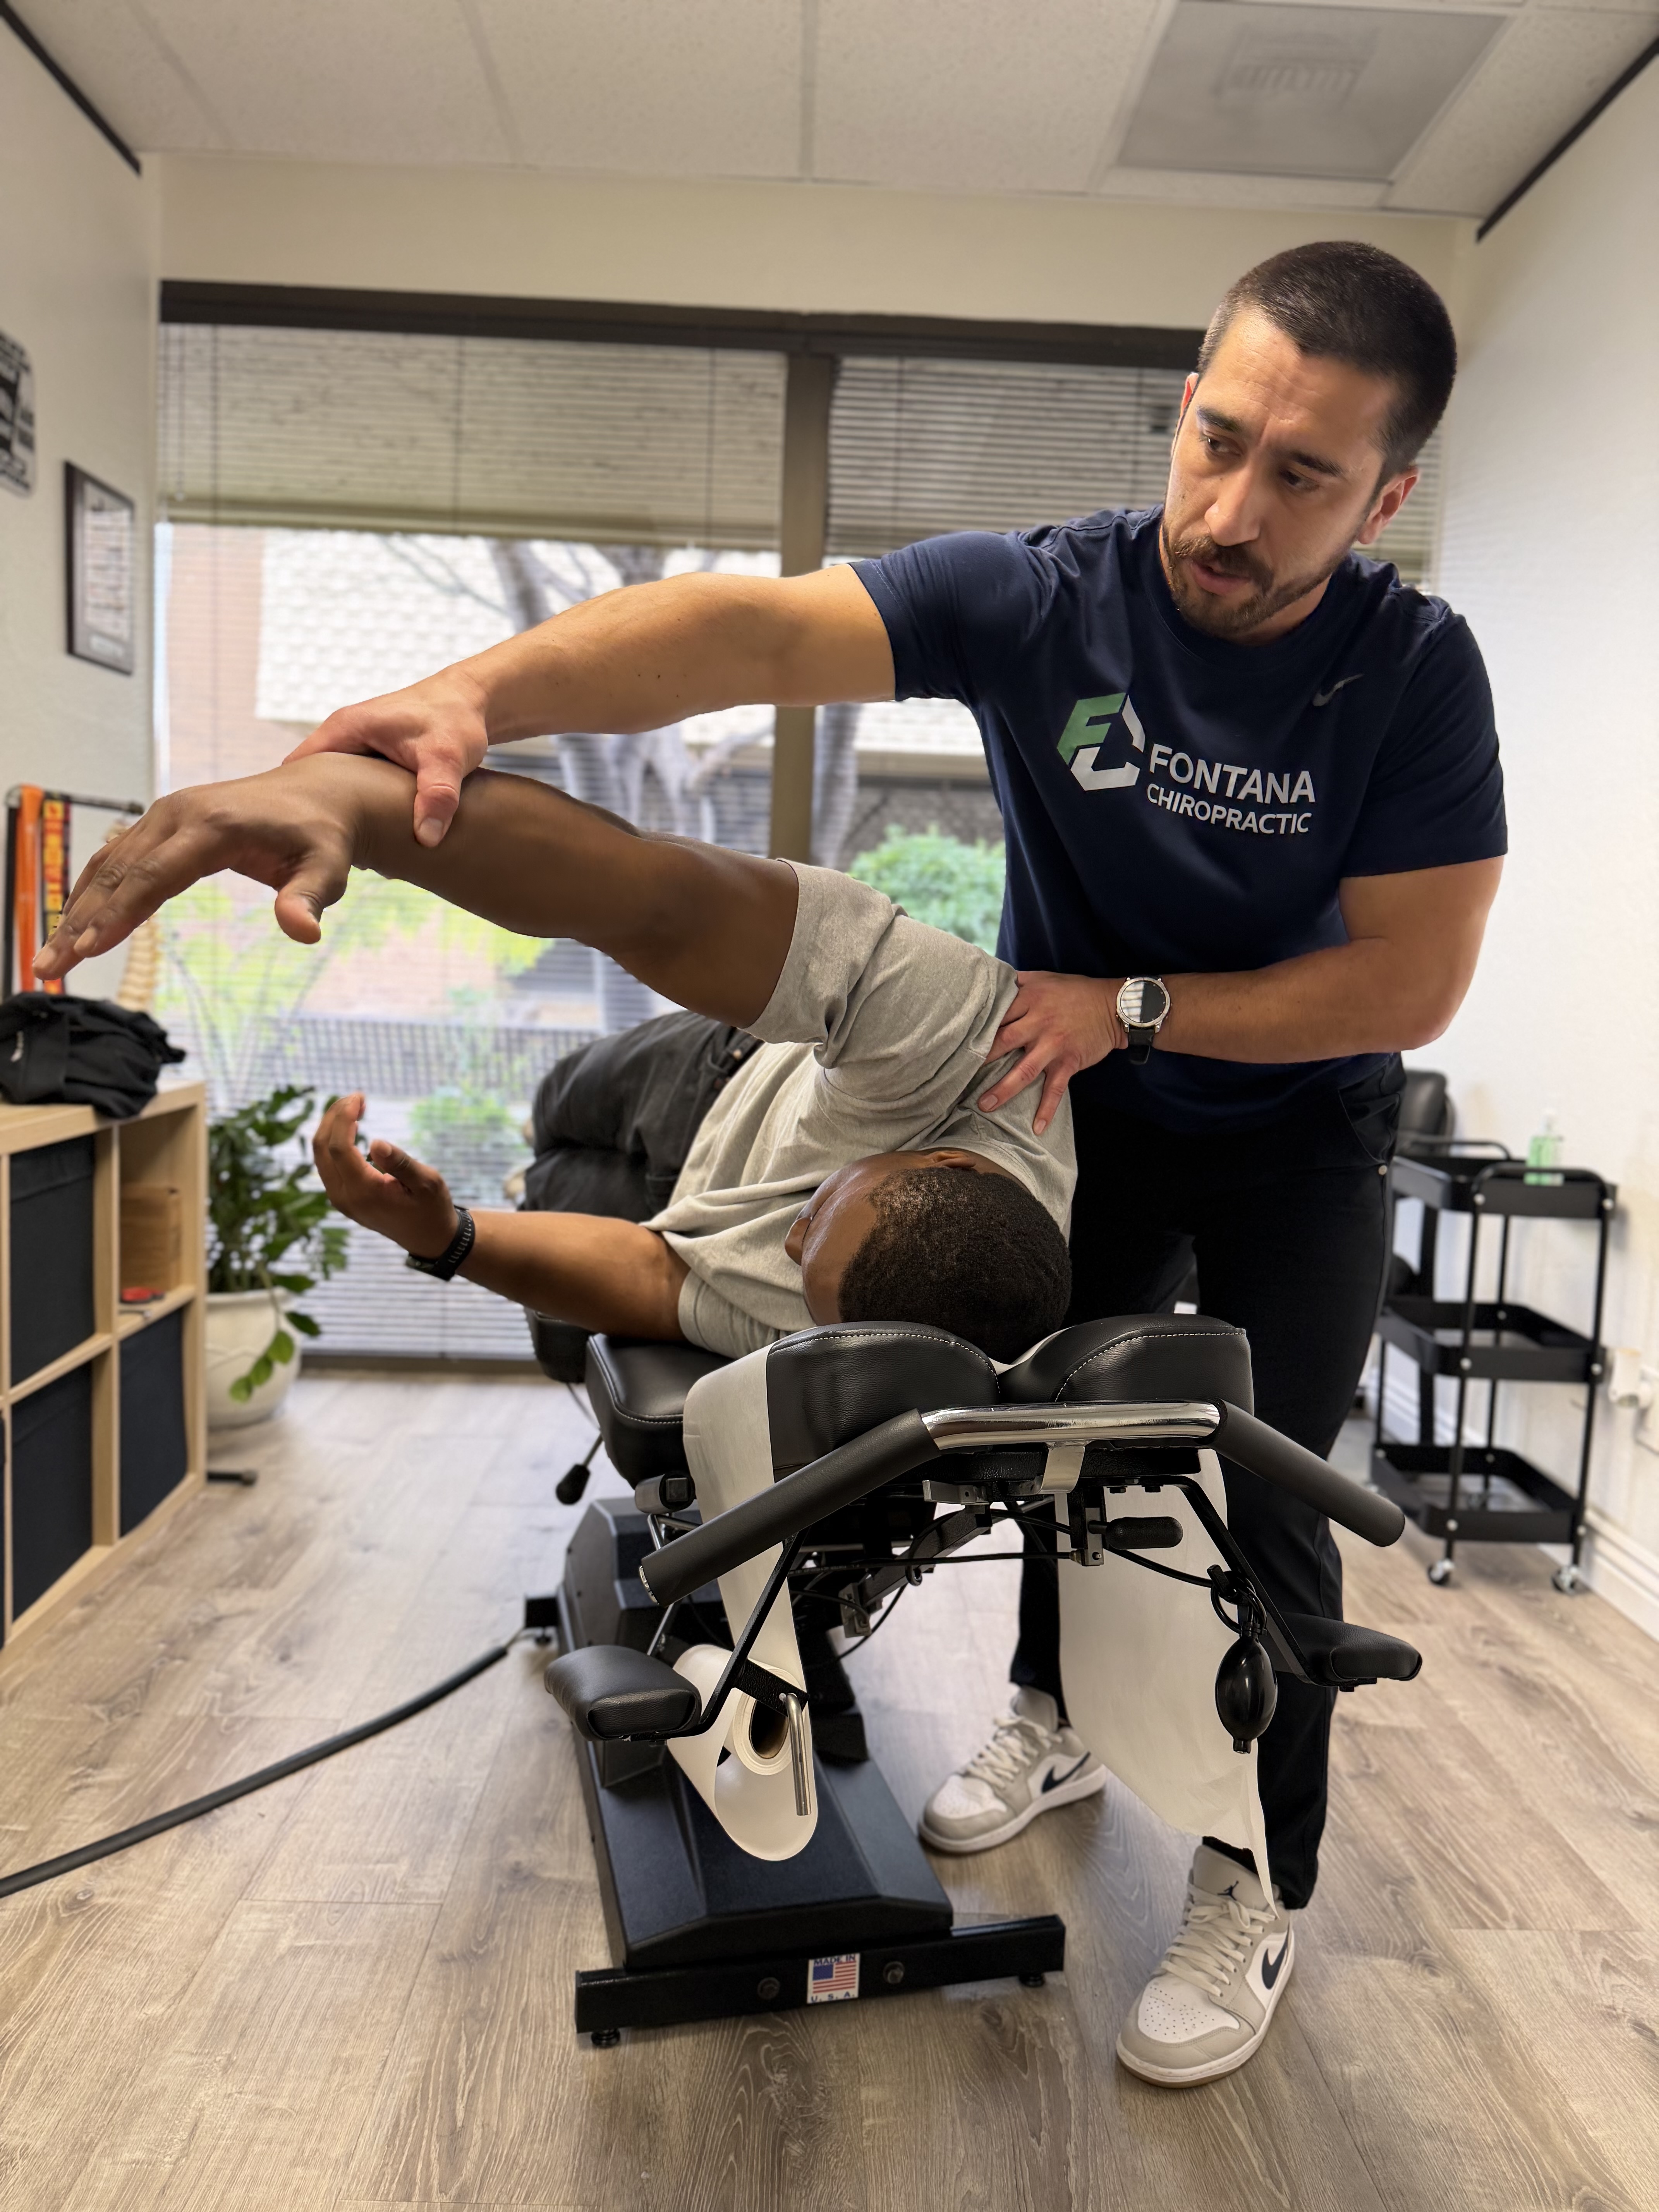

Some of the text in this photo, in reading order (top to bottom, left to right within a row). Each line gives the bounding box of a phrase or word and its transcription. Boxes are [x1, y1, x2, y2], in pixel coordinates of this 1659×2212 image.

[1150, 743, 1315, 804] FONTANA
[1147, 783, 1312, 834] CHIROPRACTIC
[814, 1956, 843, 1965] MADE
